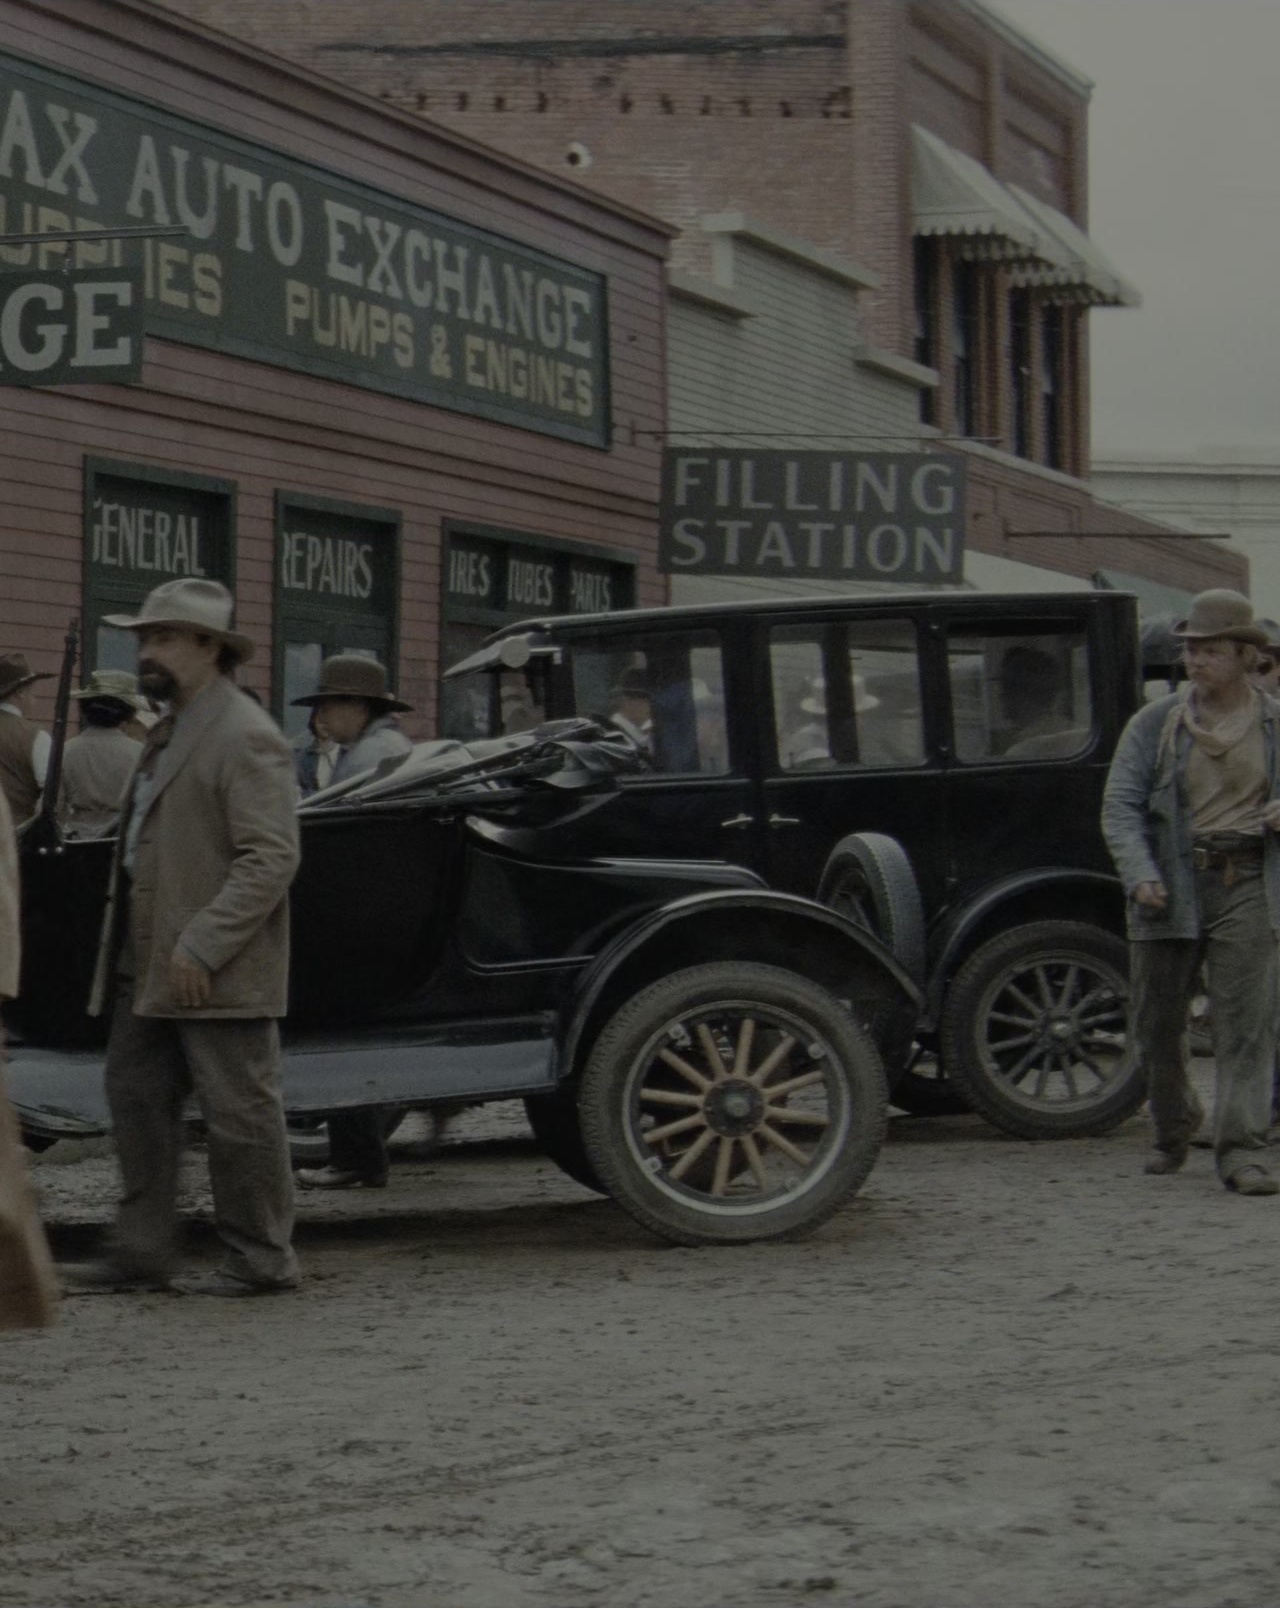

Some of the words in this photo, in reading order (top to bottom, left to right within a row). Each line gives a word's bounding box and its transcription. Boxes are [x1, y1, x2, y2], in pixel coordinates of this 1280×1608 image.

[126, 135, 303, 266] AUTO
[324, 199, 592, 359] EXCHANGE
[286, 279, 415, 368] PUMPS
[430, 325, 452, 379] &
[465, 334, 592, 417] ENGINES
[674, 457, 955, 515] FILLING
[449, 549, 490, 596] IRES
[670, 518, 953, 573] STATION
